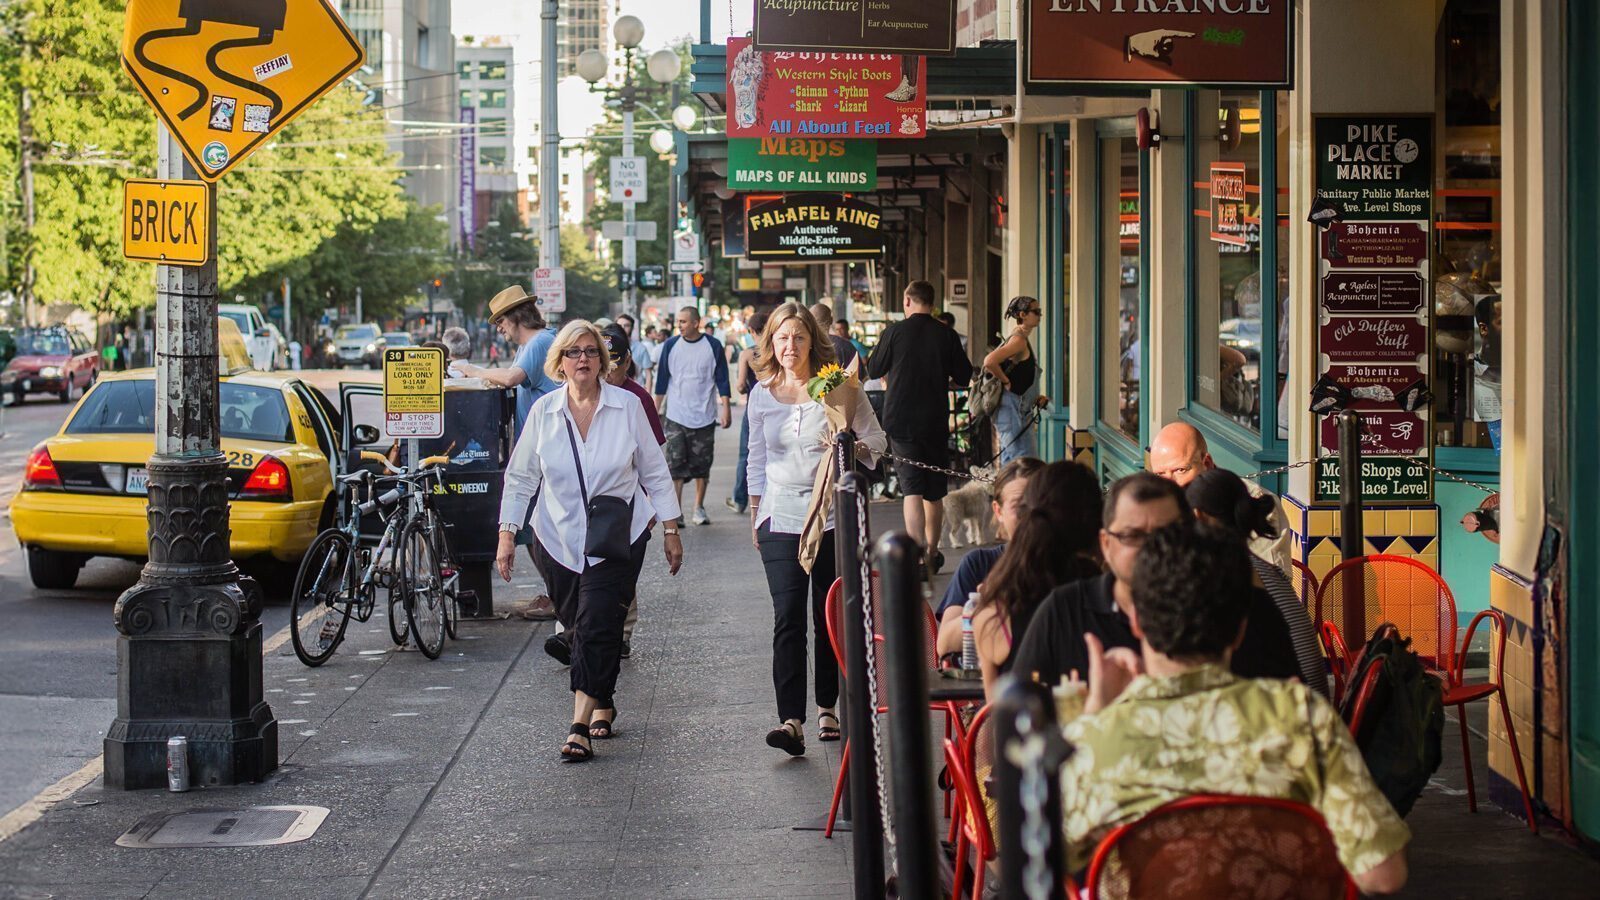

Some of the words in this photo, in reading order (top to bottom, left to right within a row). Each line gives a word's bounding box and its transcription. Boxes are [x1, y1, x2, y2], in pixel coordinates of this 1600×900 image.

[868, 2, 890, 10] Herbs
[867, 20, 880, 28] Ear
[882, 20, 929, 29] Acupuncture
[255, 55, 289, 75] #EFFJAY
[776, 68, 826, 80] Western
[829, 68, 858, 82] Style
[862, 69, 892, 80] Boots
[795, 86, 828, 97] Caiman
[839, 86, 869, 98] Python
[795, 101, 822, 112] Shark
[839, 101, 868, 112] Lizard
[769, 119, 792, 134] All
[797, 120, 849, 134] About
[854, 121, 892, 135] Feet
[1347, 124, 1398, 142] PIKE
[758, 137, 846, 162] Maps
[1328, 144, 1392, 162] PLACE
[620, 161, 636, 169] NO
[735, 170, 773, 182] MAPS
[778, 170, 795, 183] OF
[798, 171, 822, 183] ALL
[826, 171, 867, 184] KINDS
[1336, 164, 1403, 180] MARKET
[1317, 188, 1359, 201] Sanitary
[1362, 188, 1392, 199] Public
[1395, 188, 1430, 199] Market
[1364, 202, 1389, 212] Level
[1392, 202, 1422, 214] Shops
[131, 199, 198, 245] BRICK
[750, 206, 831, 231] FALAFEL
[835, 207, 881, 230] KING
[792, 225, 838, 235] Authentic
[1346, 224, 1400, 236] Bohemia
[779, 236, 852, 245] Middle-Eastern
[797, 246, 834, 256] Cuisine
[1347, 255, 1374, 264] Western
[1376, 255, 1394, 265] Style
[1396, 255, 1414, 264] Boots
[536, 269, 549, 278] NO
[1349, 280, 1377, 293] Ageless
[1327, 292, 1377, 304] Acupuncture
[1334, 320, 1355, 341] Old
[1358, 319, 1406, 336] Duffers
[1376, 333, 1410, 349] Stuff
[389, 351, 402, 360] 30
[393, 371, 413, 379] LOAD
[415, 371, 434, 379] ONLY
[1346, 366, 1400, 377] Bohemia
[220, 449, 254, 467] 28
[469, 449, 490, 459] Times
[1361, 463, 1402, 480] Shops
[1406, 465, 1424, 477] on
[1317, 480, 1341, 495] Pik
[1361, 480, 1389, 495] lace
[1392, 480, 1428, 495] Level
